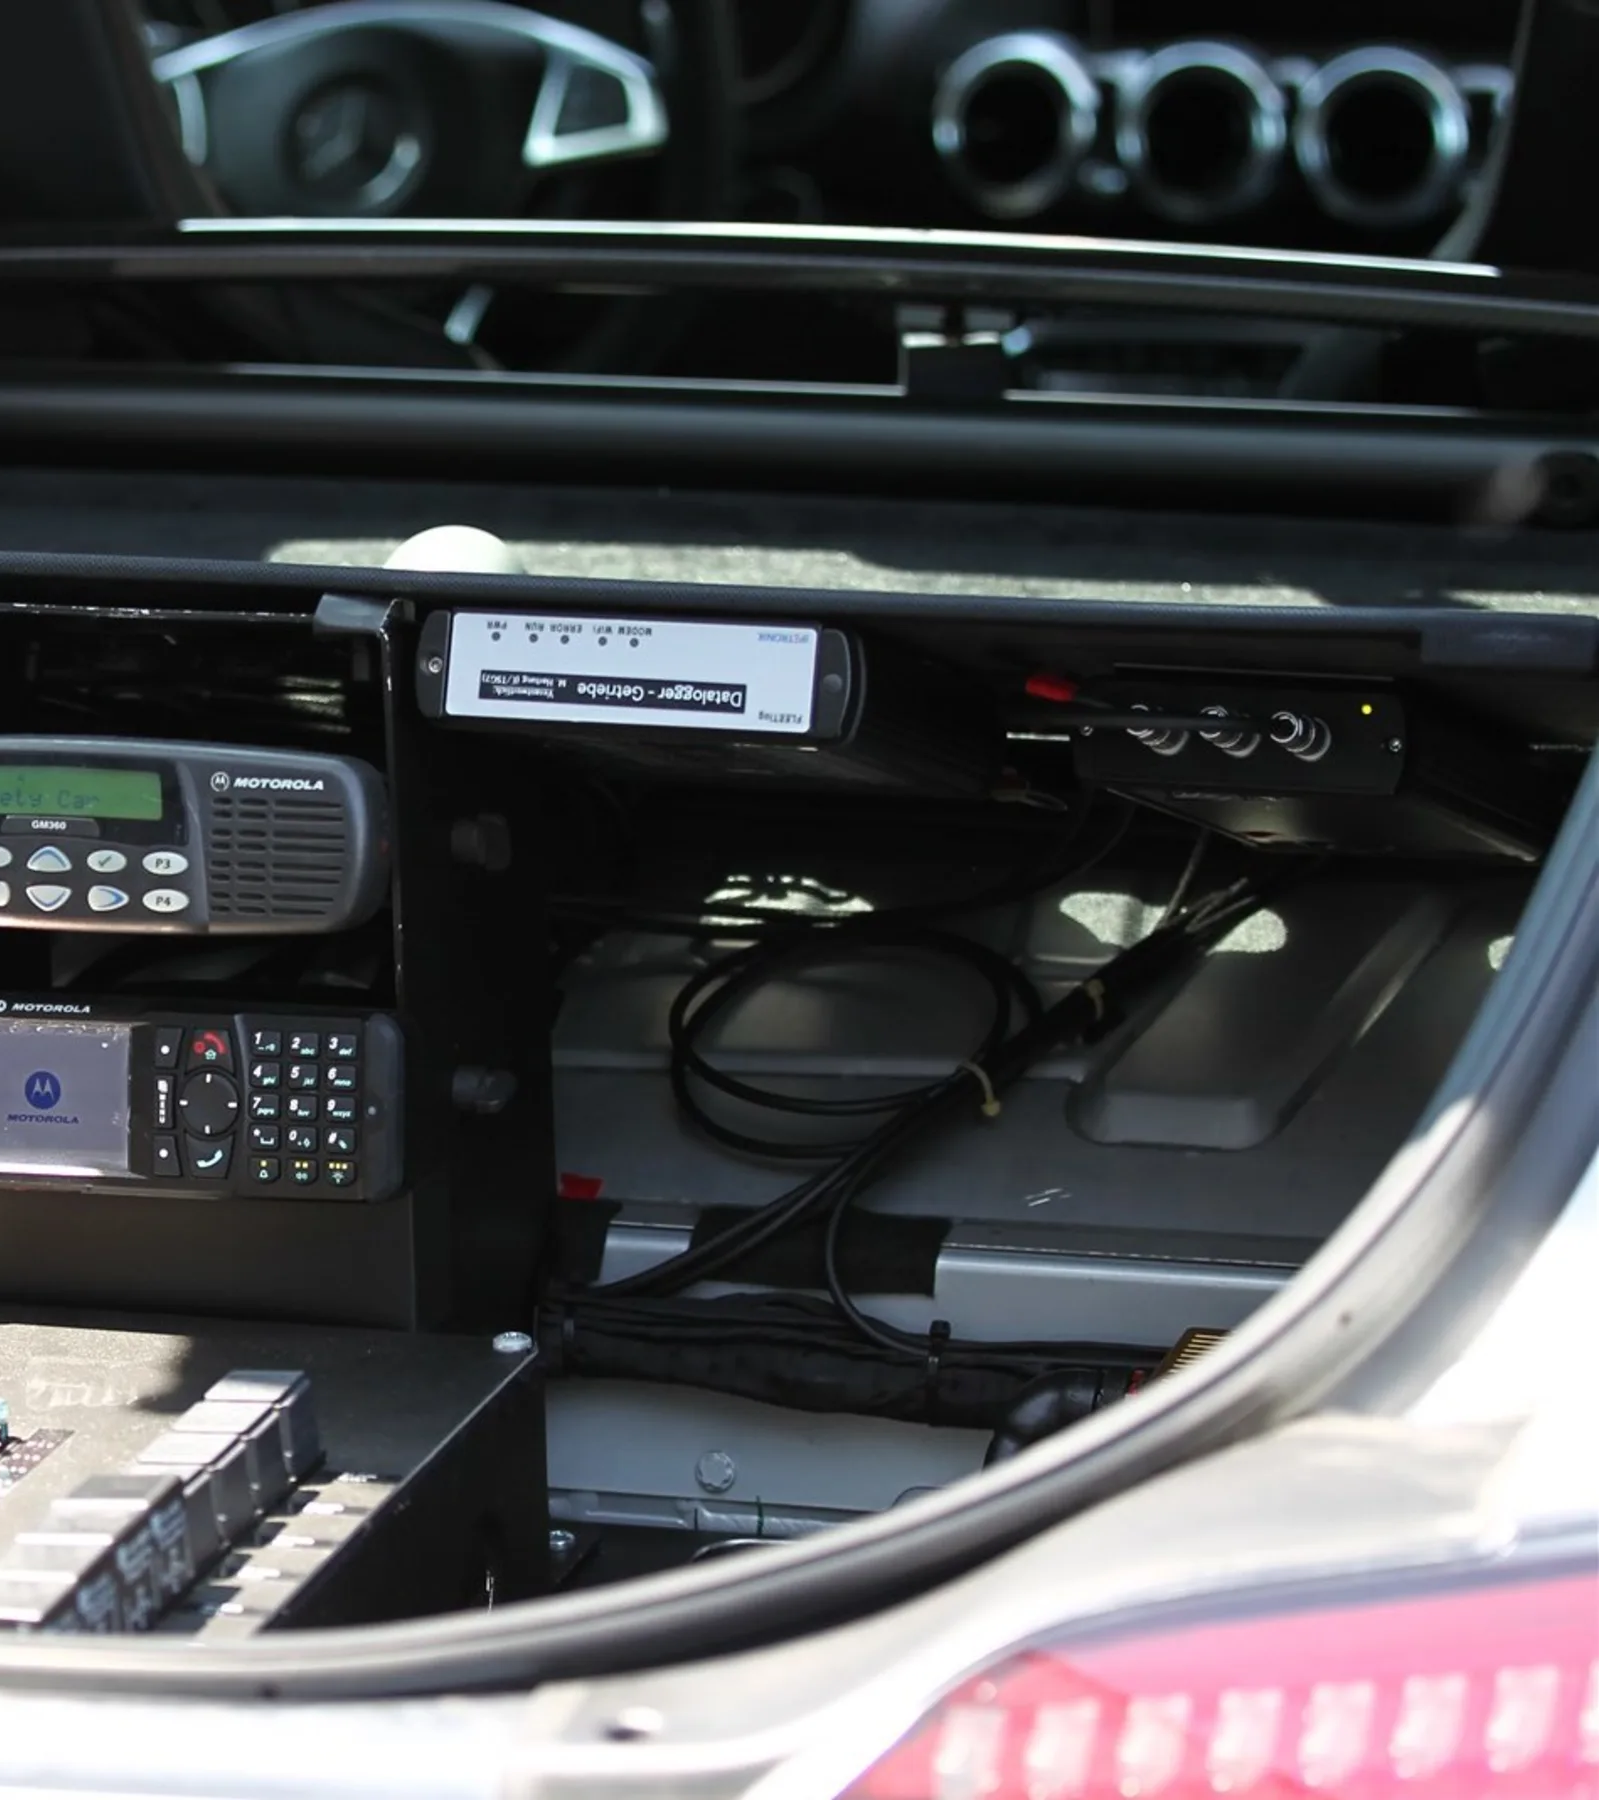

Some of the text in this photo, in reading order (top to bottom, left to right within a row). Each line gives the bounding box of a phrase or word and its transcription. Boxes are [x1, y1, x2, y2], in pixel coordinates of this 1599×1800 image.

[525, 621, 544, 631] RUN
[550, 623, 582, 633] ERROR
[618, 626, 652, 636] MODEM
[577, 682, 644, 701] Getriebe
[658, 684, 743, 707] Datalogger
[233, 777, 324, 790] MOTOROLA
[57, 789, 100, 810] Car
[31, 819, 67, 831] GM360
[155, 859, 171, 869] P3
[155, 896, 171, 907] P4
[11, 1003, 91, 1013] MOTOROLA
[254, 1032, 262, 1045] 1
[291, 1037, 300, 1049] 2
[328, 1037, 338, 1049] 3
[253, 1065, 262, 1078] 4
[290, 1066, 300, 1078] 5
[327, 1067, 337, 1080] 6
[253, 1096, 261, 1109] 7
[289, 1099, 299, 1111] 8
[327, 1099, 336, 1111] 9
[6, 1113, 80, 1124] MOTOROLA
